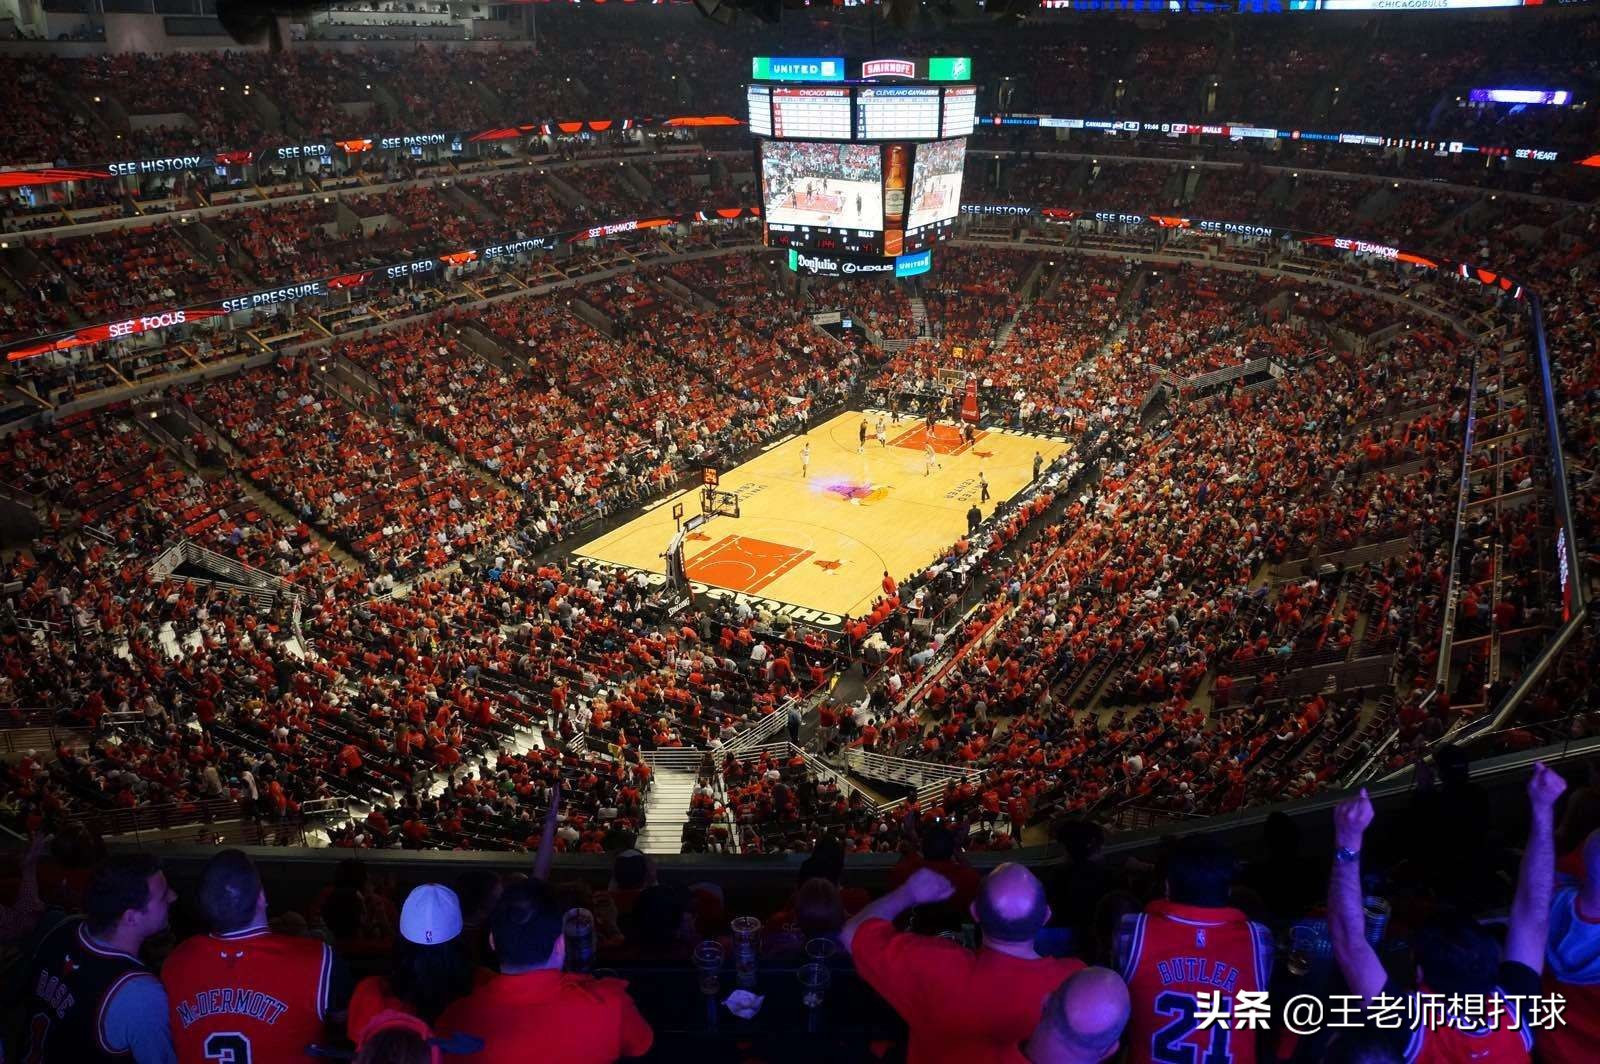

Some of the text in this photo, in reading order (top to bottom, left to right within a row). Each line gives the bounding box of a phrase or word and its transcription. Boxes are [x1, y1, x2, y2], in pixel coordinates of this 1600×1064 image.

[774, 65, 819, 74] UNITED
[382, 134, 445, 149] SEE PASSION
[278, 145, 326, 160] SEE RED
[108, 156, 200, 177] SEE HISTORY
[961, 205, 1031, 216] SEE HISTORY
[1096, 212, 1141, 224] SEE RED
[588, 221, 638, 238] SEE TEAMWORK
[1200, 221, 1272, 237] SEE PASSION
[485, 238, 546, 258] SEE VICTORY
[1335, 238, 1399, 258] SEE TEAMWORK
[387, 261, 433, 279] SEE RED
[857, 264, 893, 272] LEXUS
[222, 283, 320, 314] SEE PRESSURE
[108, 311, 186, 338] SEE FOCUS
[1157, 957, 1240, 992] BUTLER
[1152, 990, 1233, 1064] 21
